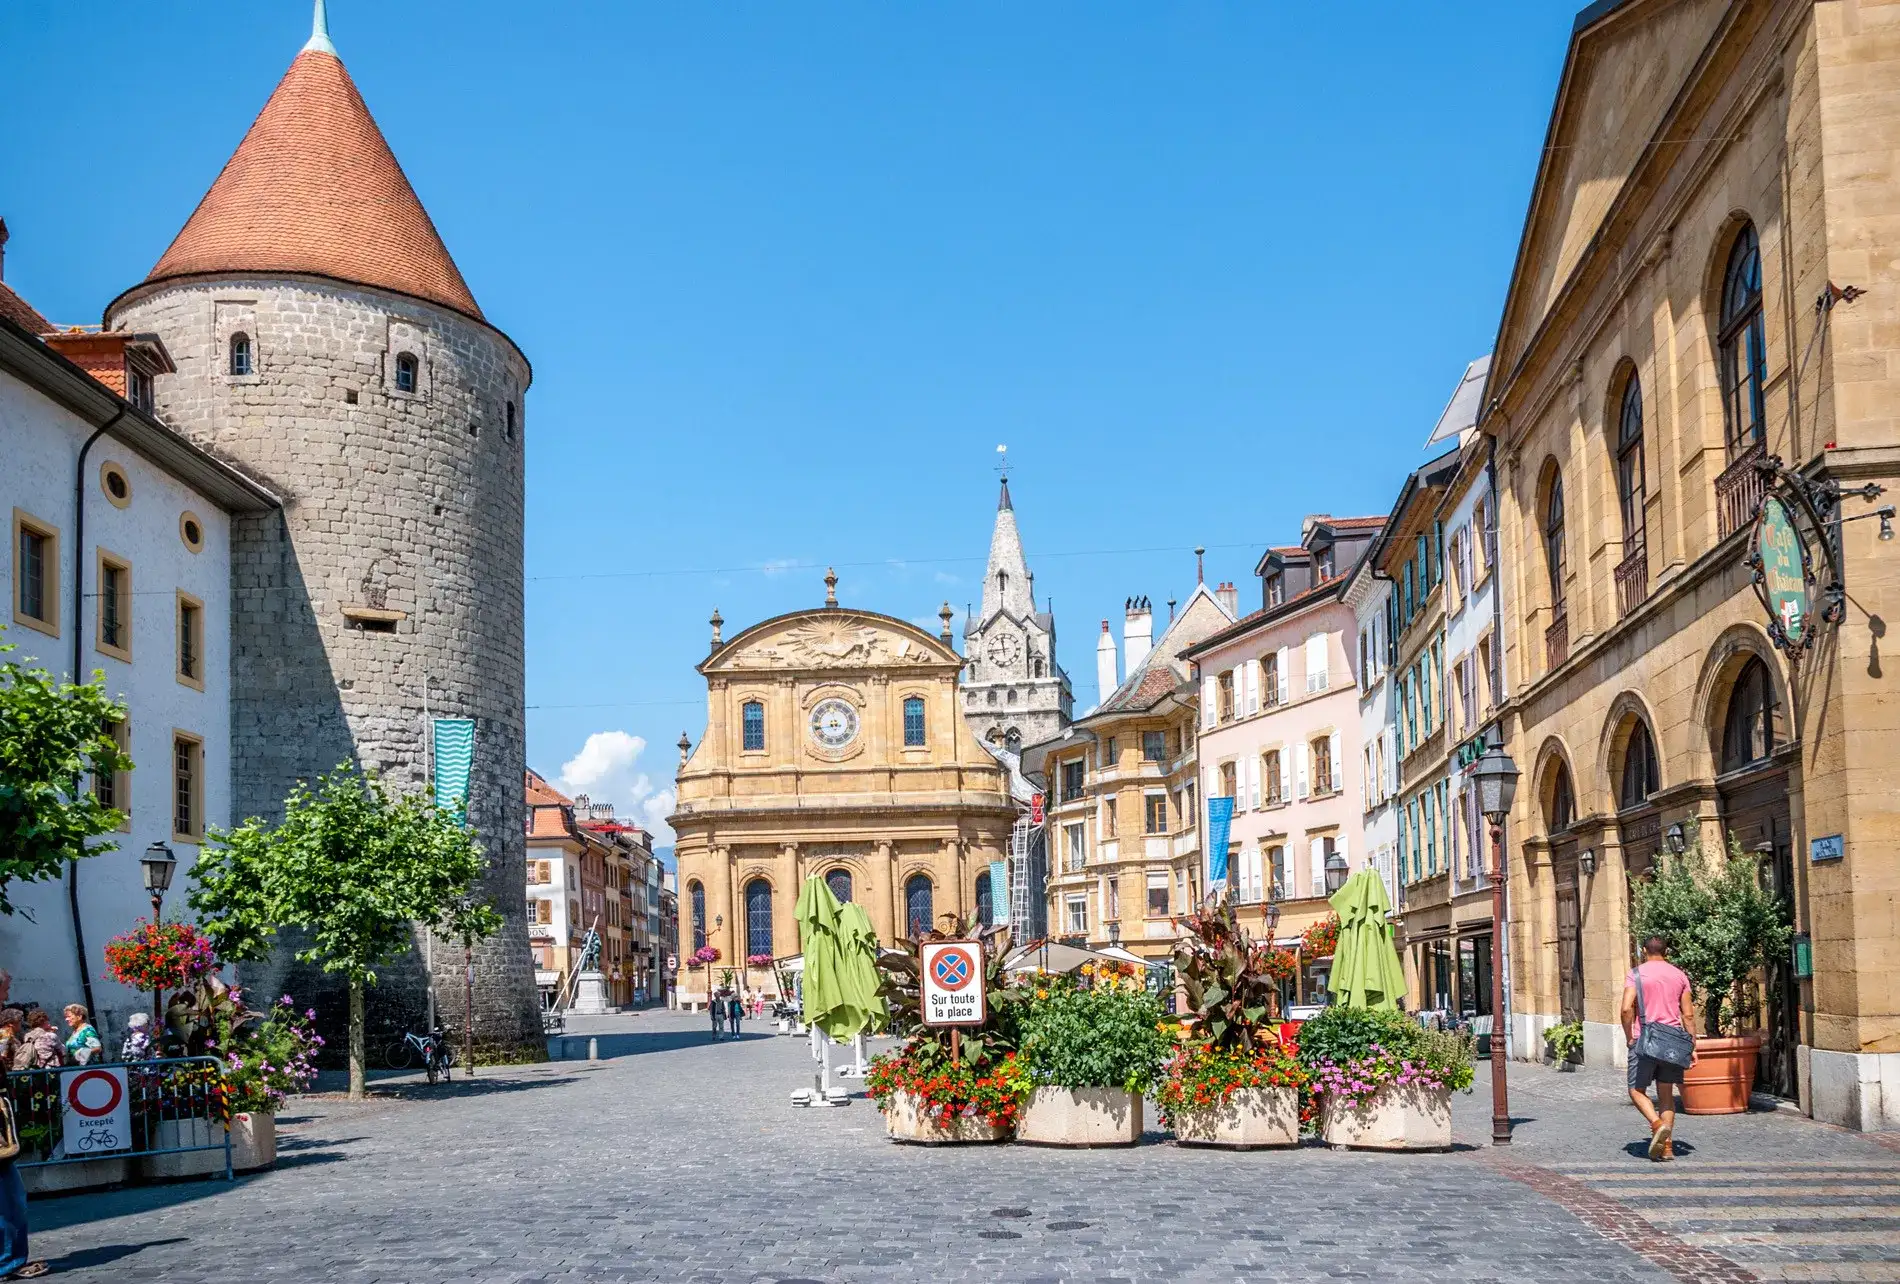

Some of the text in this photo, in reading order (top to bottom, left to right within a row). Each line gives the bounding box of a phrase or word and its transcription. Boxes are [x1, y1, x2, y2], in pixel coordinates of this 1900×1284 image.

[1776, 549, 1790, 567] du
[931, 992, 975, 1005] Sur toute
[935, 1005, 973, 1019] la place
[79, 1117, 114, 1127] Excepté
